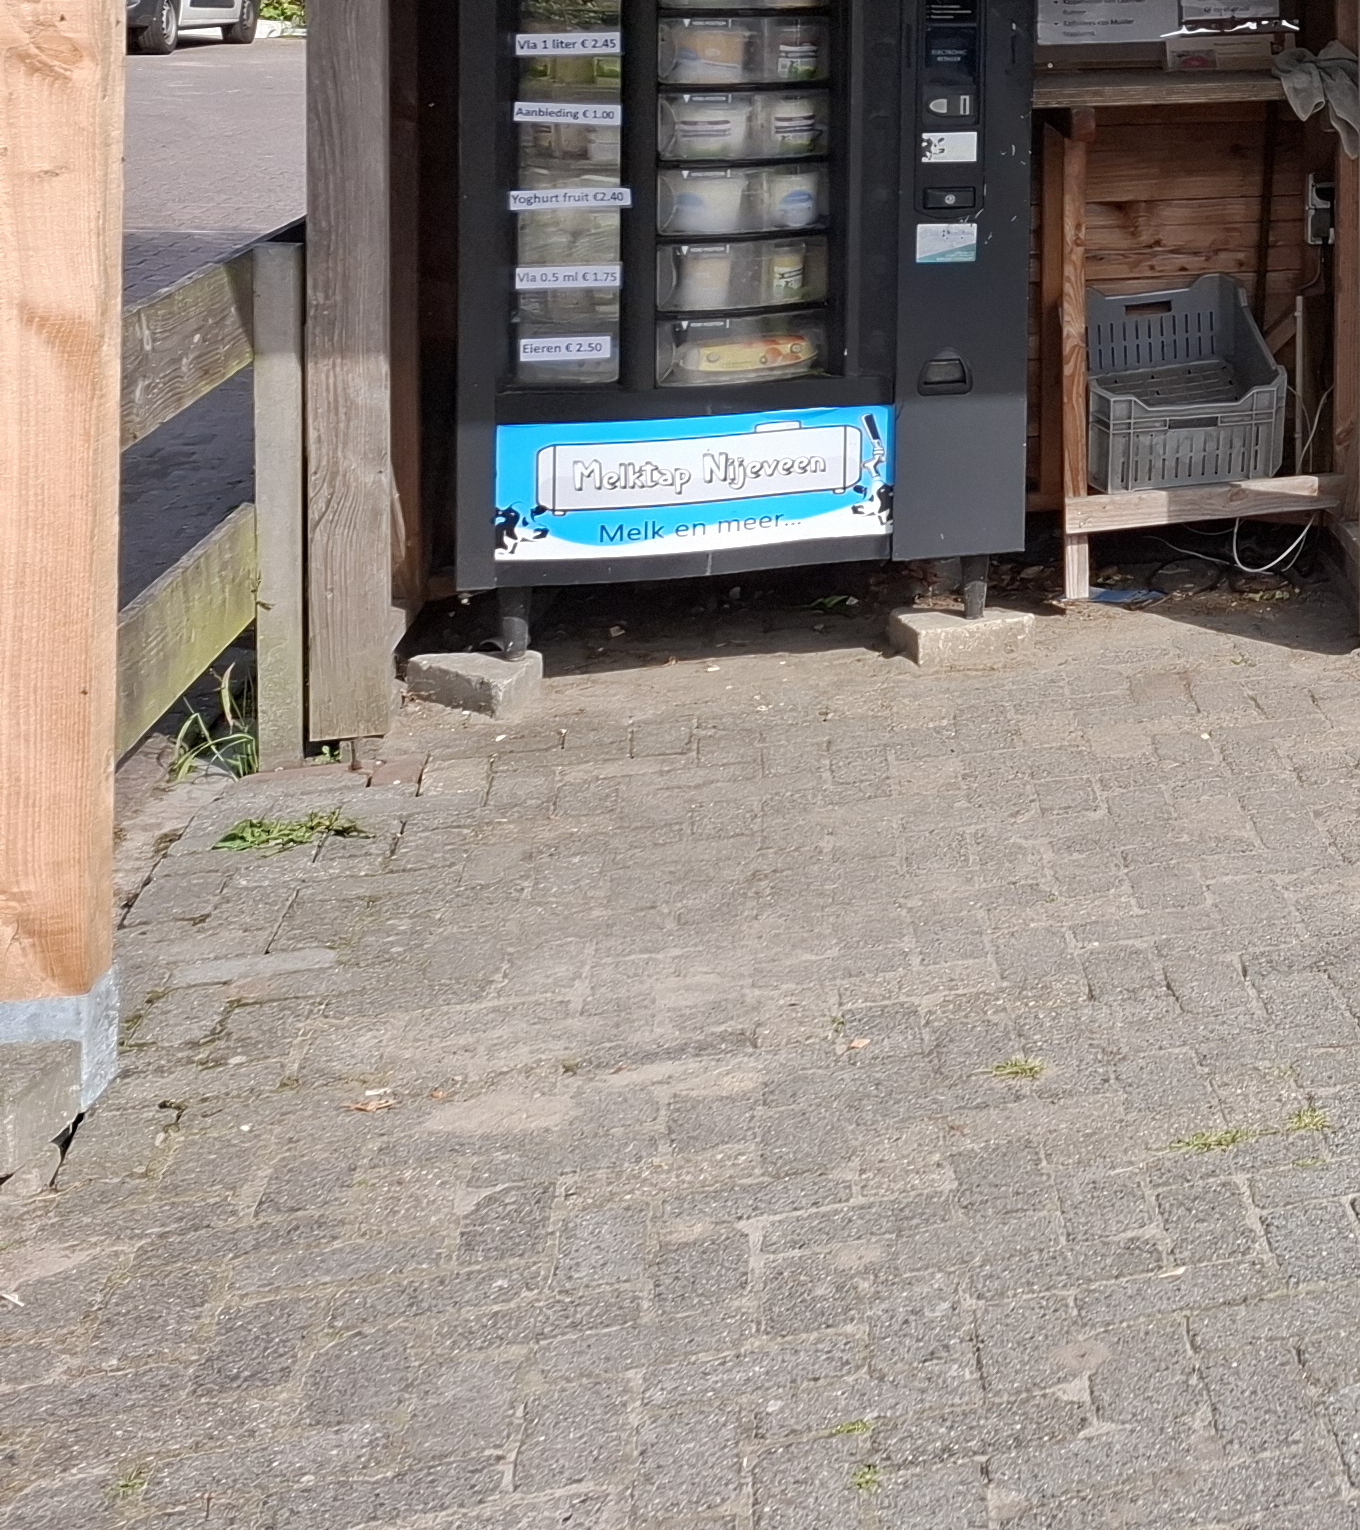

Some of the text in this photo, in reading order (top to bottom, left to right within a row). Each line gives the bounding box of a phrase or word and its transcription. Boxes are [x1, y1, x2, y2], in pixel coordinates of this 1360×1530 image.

[517, 39, 537, 50] Vla
[552, 38, 577, 49] liter
[591, 38, 617, 49] 2.45
[516, 107, 579, 120] Aanbieding
[592, 110, 615, 119] 1.00
[511, 192, 625, 206] Yoghurt fruit €2.40
[517, 272, 537, 283] Vla
[540, 272, 559, 283] 0.5
[562, 271, 579, 282] ml
[592, 272, 617, 282] 1.75
[522, 343, 561, 354] Eieren
[575, 342, 603, 353] 2.50
[572, 450, 827, 495] Melktap Nijeveen
[599, 520, 665, 544] Melk
[674, 520, 706, 538] en
